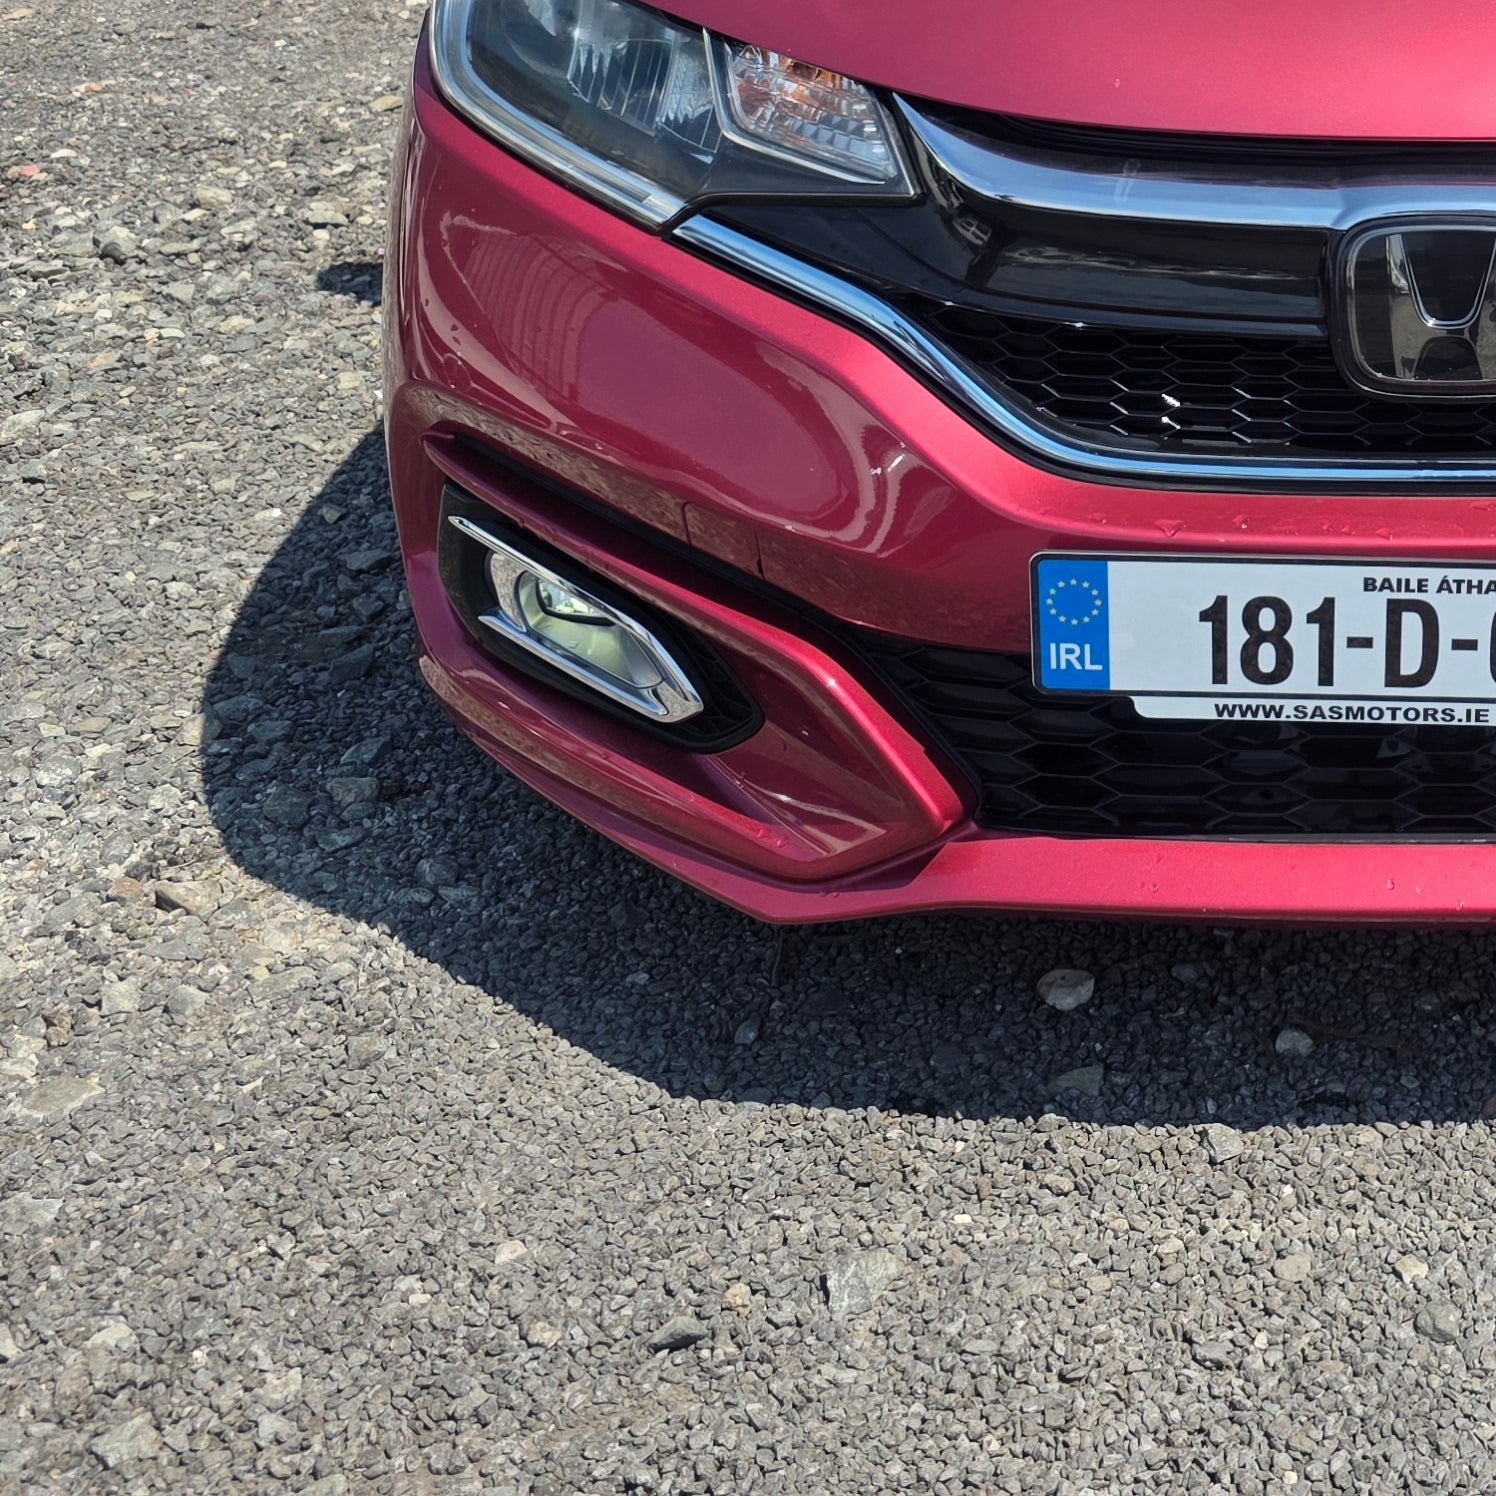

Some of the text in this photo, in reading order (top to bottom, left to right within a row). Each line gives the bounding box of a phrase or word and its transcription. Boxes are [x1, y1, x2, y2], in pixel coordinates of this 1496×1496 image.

[1363, 577, 1429, 593] BAILE
[1050, 642, 1103, 670] IRL
[1214, 703, 1490, 723] WWW.SASMOTORS.IE
